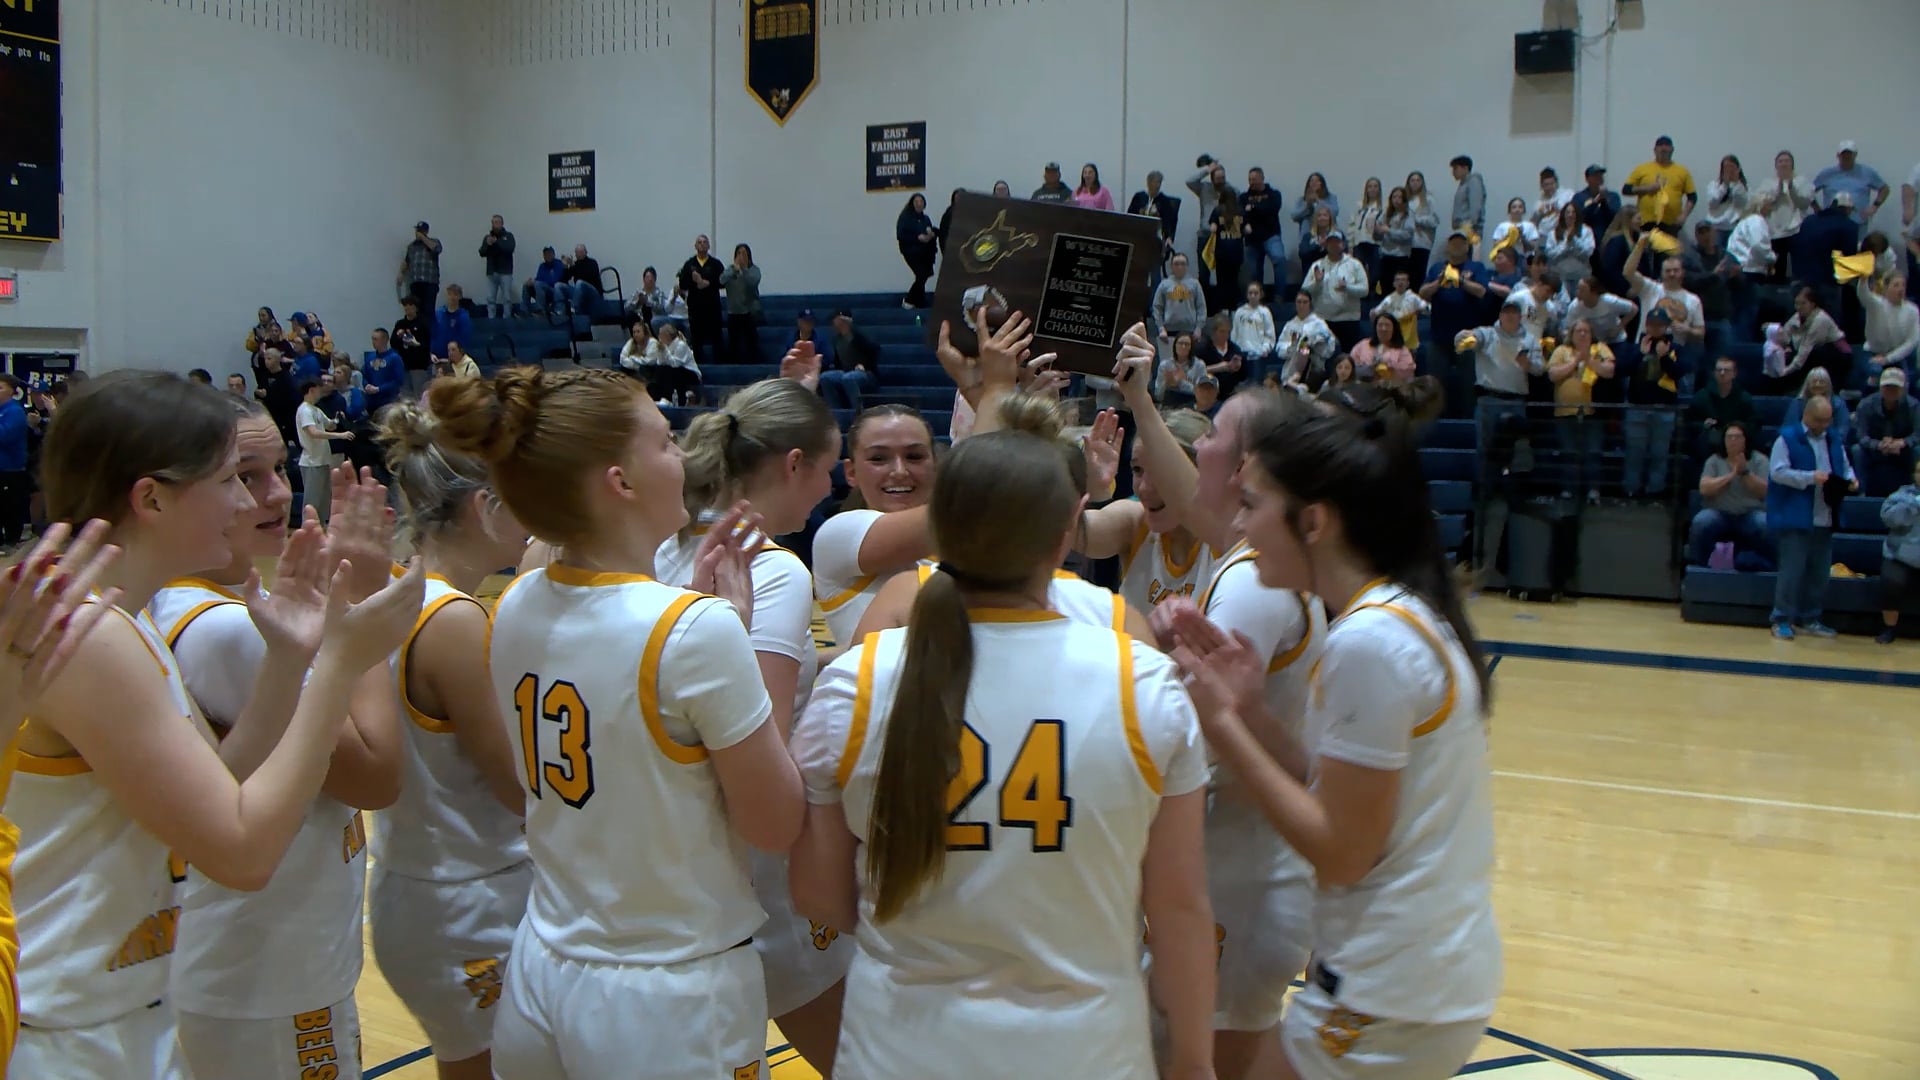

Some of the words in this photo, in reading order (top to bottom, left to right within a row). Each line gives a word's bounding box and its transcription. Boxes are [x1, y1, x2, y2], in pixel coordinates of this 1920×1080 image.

[883, 127, 909, 140] EAST
[871, 138, 920, 153] FAIRMONT
[561, 155, 581, 167] EAST
[882, 151, 909, 164] BAND
[552, 165, 591, 178] FAIRMONT
[875, 162, 916, 177] SECTION
[561, 177, 582, 188] BAND
[556, 187, 587, 199] SECTION
[1049, 277, 1118, 299] BASKETBALL
[1049, 308, 1105, 326] REGIONAL
[1044, 320, 1107, 338] CHAMPION
[514, 672, 595, 809] 13
[945, 719, 1074, 853] 24
